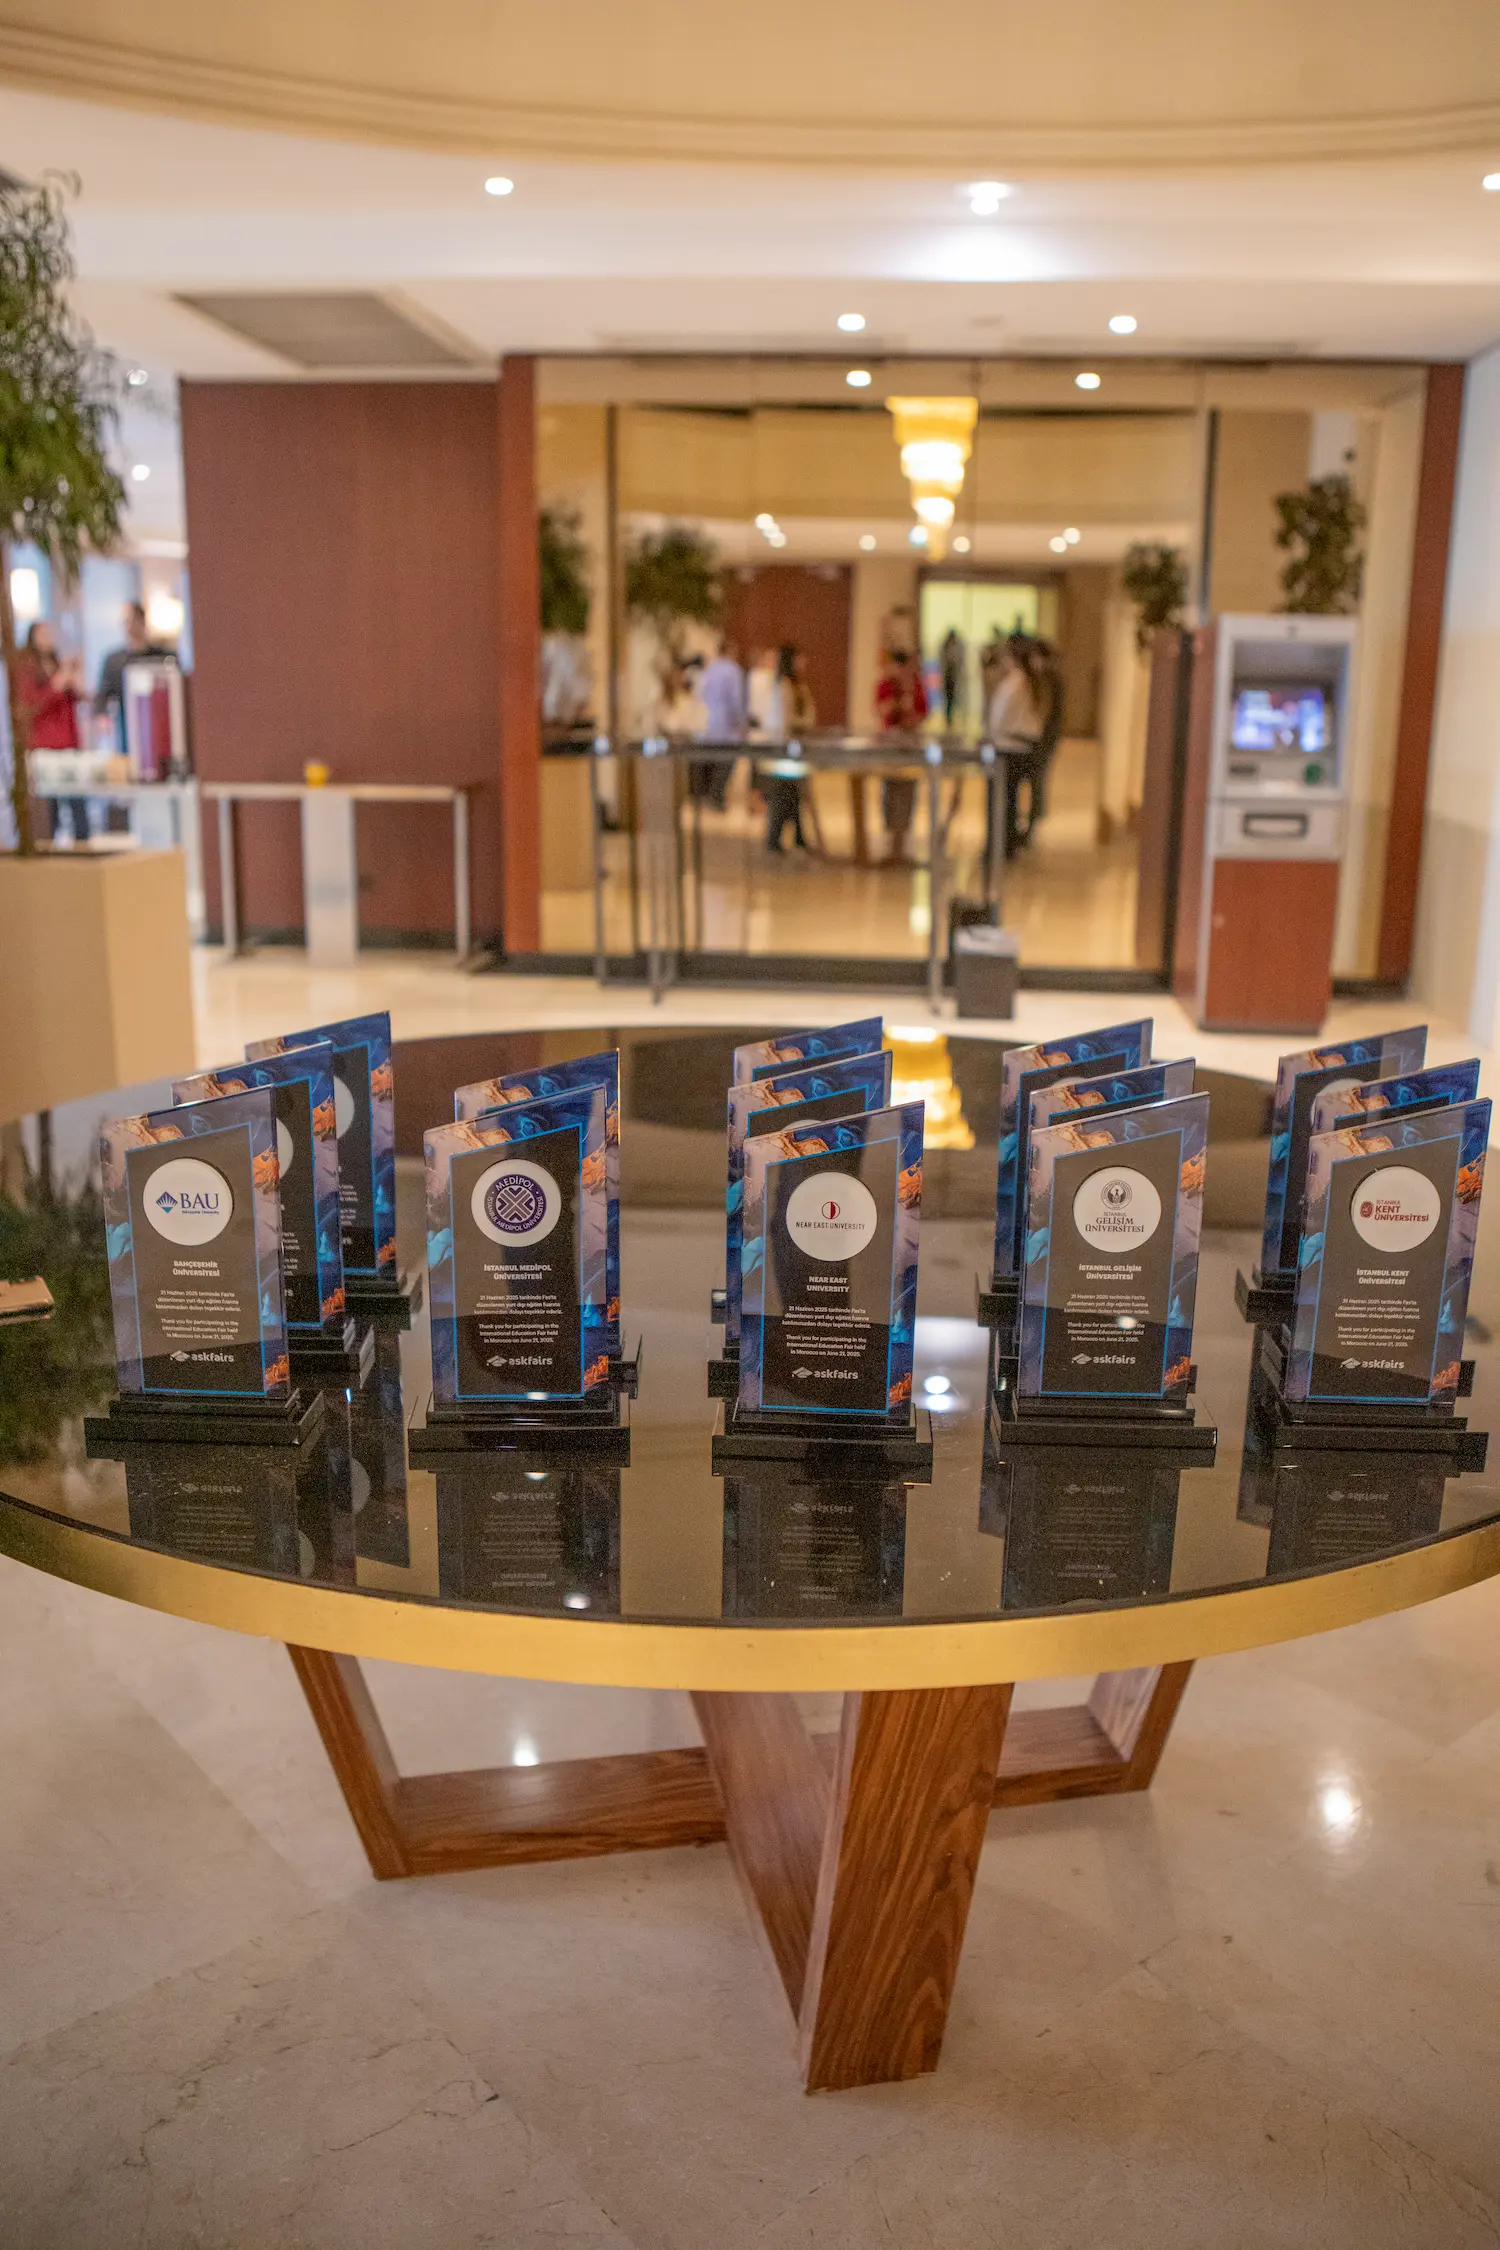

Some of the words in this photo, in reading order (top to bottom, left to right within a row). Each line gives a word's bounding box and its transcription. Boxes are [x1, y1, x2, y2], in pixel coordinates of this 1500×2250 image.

[495, 1175, 535, 1191] MEDİPOL
[180, 1193, 219, 1209] BAU
[1096, 1216, 1134, 1225] GELİŞİM
[1374, 1213, 1429, 1222] ÜNİVERSİTESİ
[496, 1220, 523, 1231] MEDİPOL
[1085, 1224, 1144, 1232] ÜNİVERSİTESİ
[173, 1260, 218, 1269] BAHÇEŞEHİR
[1113, 1264, 1141, 1272] GELİŞİM
[172, 1268, 220, 1277] ÜNİVERSİTESİ
[493, 1272, 542, 1280] ÜNİVERSİTESİ
[191, 1352, 234, 1362] askfairs
[509, 1356, 553, 1366] askfairs
[1093, 1355, 1136, 1364] askfairs
[1362, 1360, 1404, 1369] askfairs
[814, 1369, 858, 1379] askfairs
